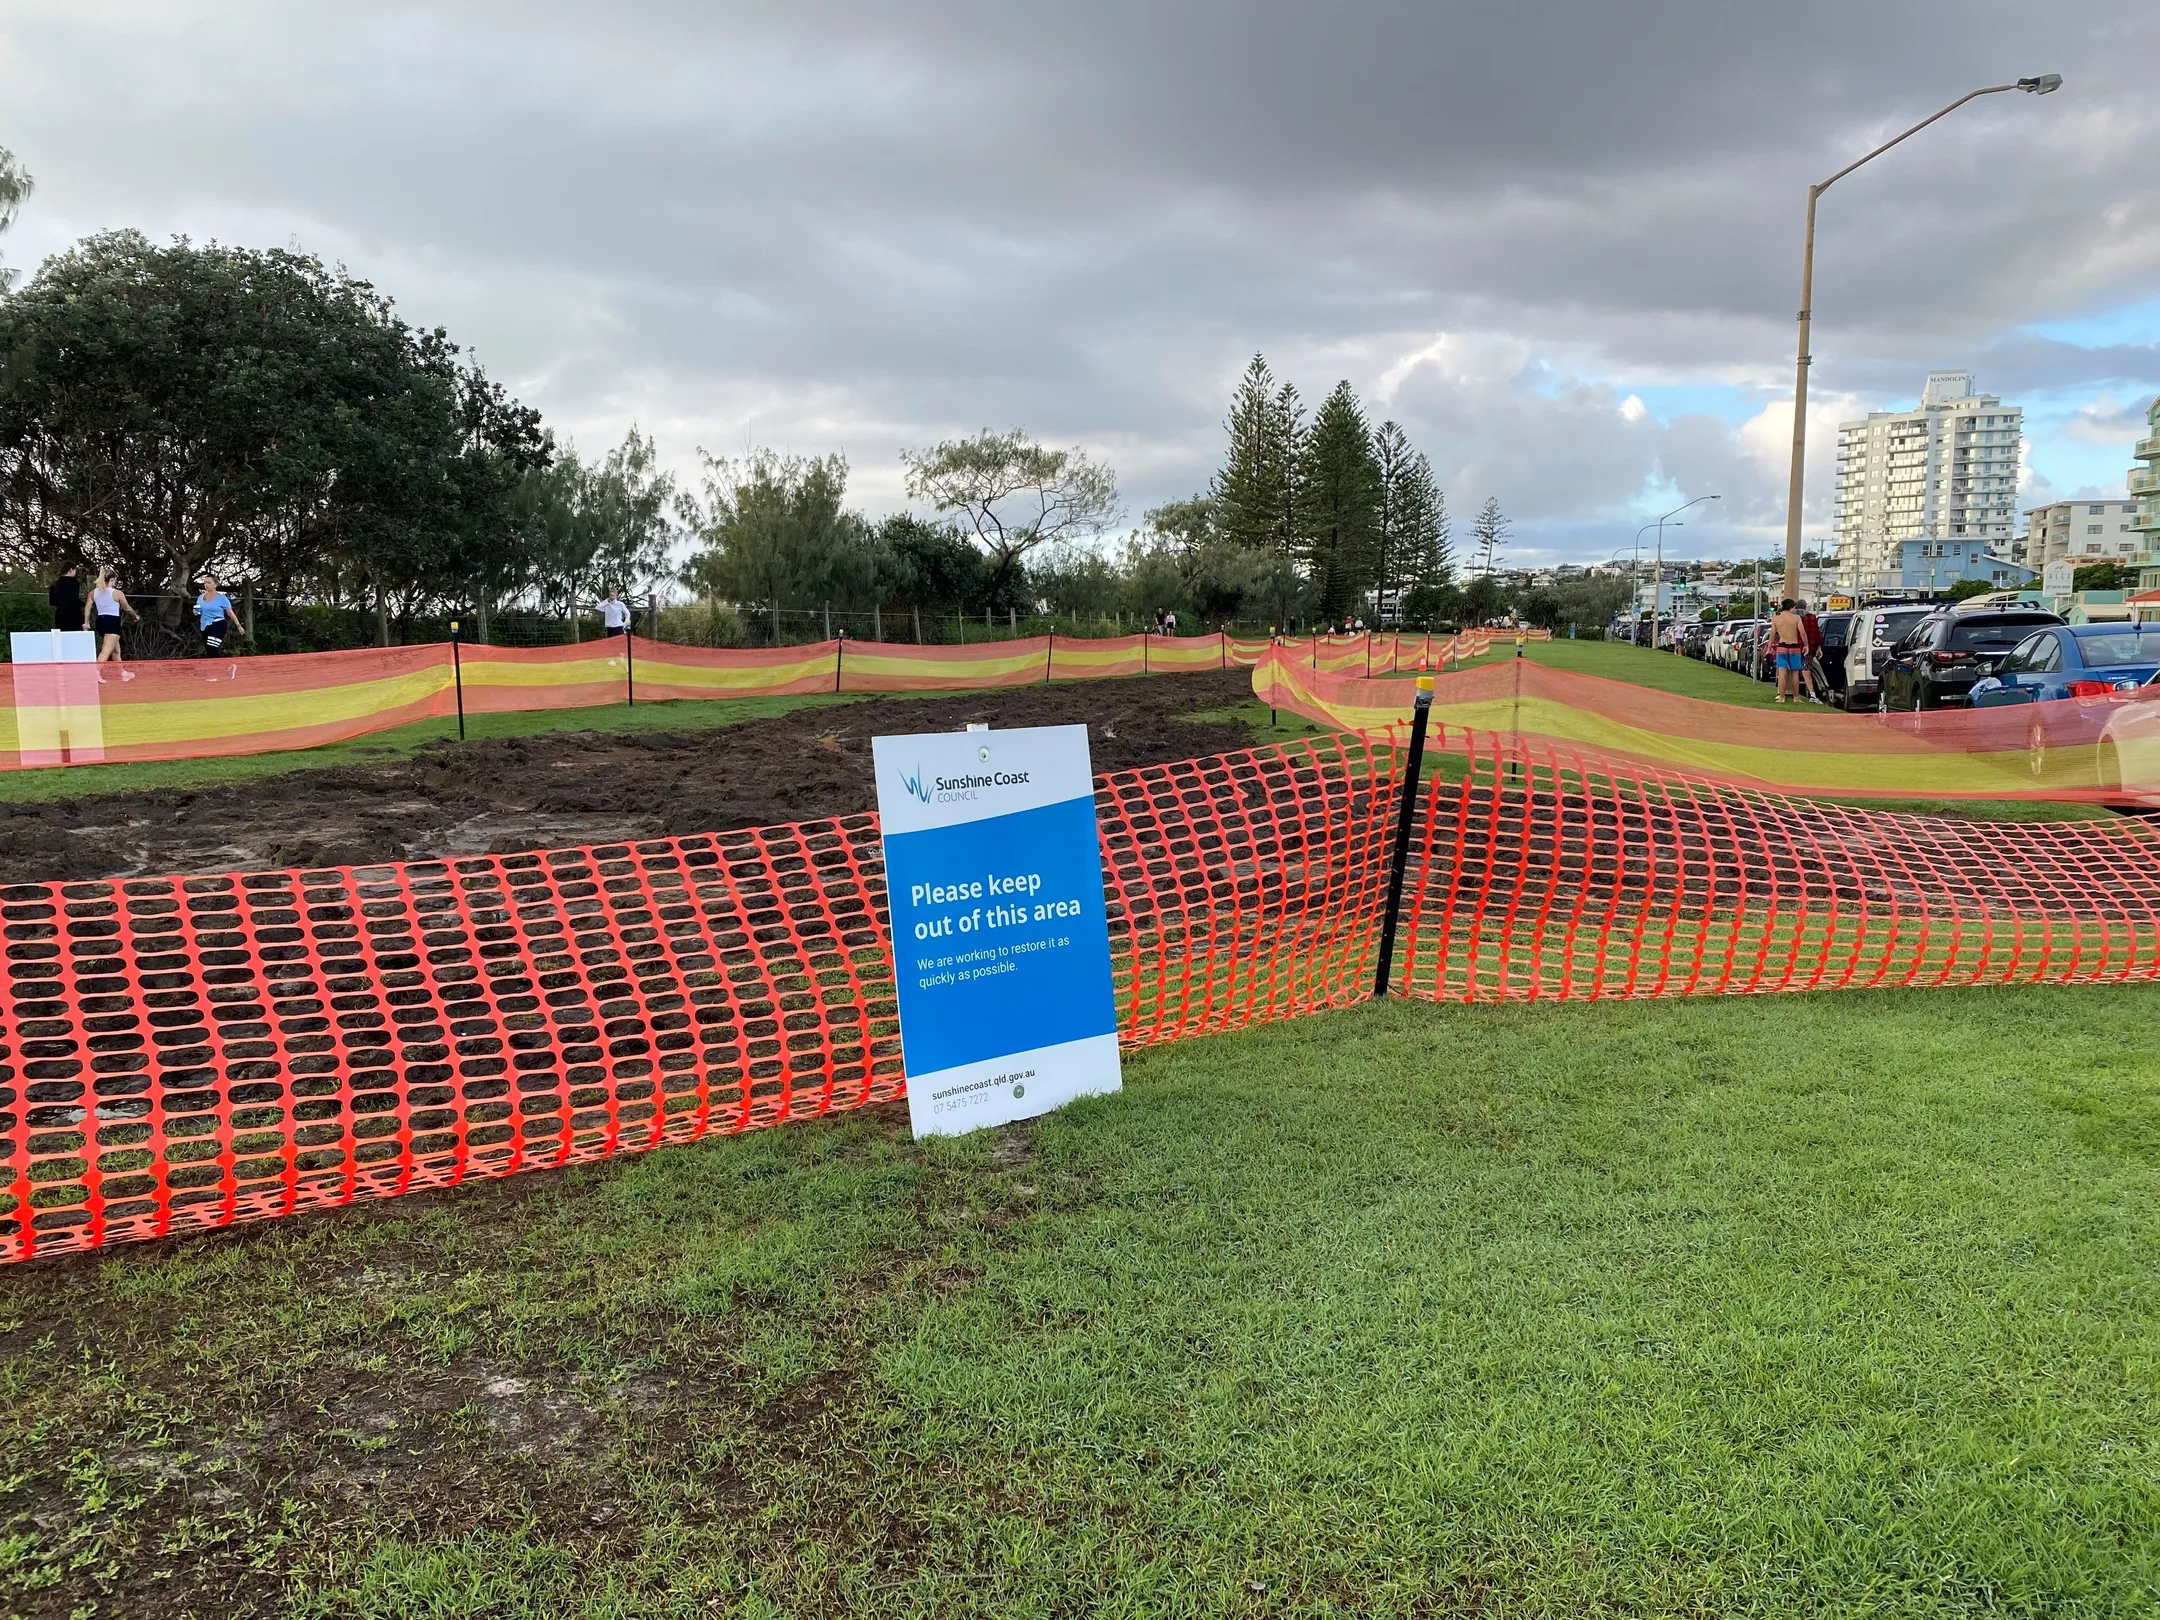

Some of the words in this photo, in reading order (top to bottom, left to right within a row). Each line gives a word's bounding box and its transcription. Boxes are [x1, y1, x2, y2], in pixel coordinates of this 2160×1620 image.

[936, 774, 993, 791] Sunshine
[994, 771, 1030, 786] Coast
[937, 790, 979, 803] COUNCIL
[911, 880, 983, 907] Please
[988, 872, 1041, 897] keep
[914, 915, 954, 940] out
[958, 908, 981, 933] of
[985, 903, 1028, 929] this
[1033, 898, 1081, 922] area
[917, 958, 935, 971] We
[936, 956, 954, 968] are
[955, 949, 996, 964] working
[998, 945, 1009, 957] to
[1011, 939, 1047, 955] restore
[1048, 937, 1056, 948] it
[1057, 936, 1070, 946] as
[919, 971, 956, 990] quickly
[957, 969, 971, 981] as
[972, 960, 1019, 981] possible.
[931, 1068, 1036, 1101] sunshinecoast.qld.gov.au
[933, 1103, 945, 1115] 07
[946, 1098, 967, 1112] 5475
[968, 1091, 989, 1105] 7272
